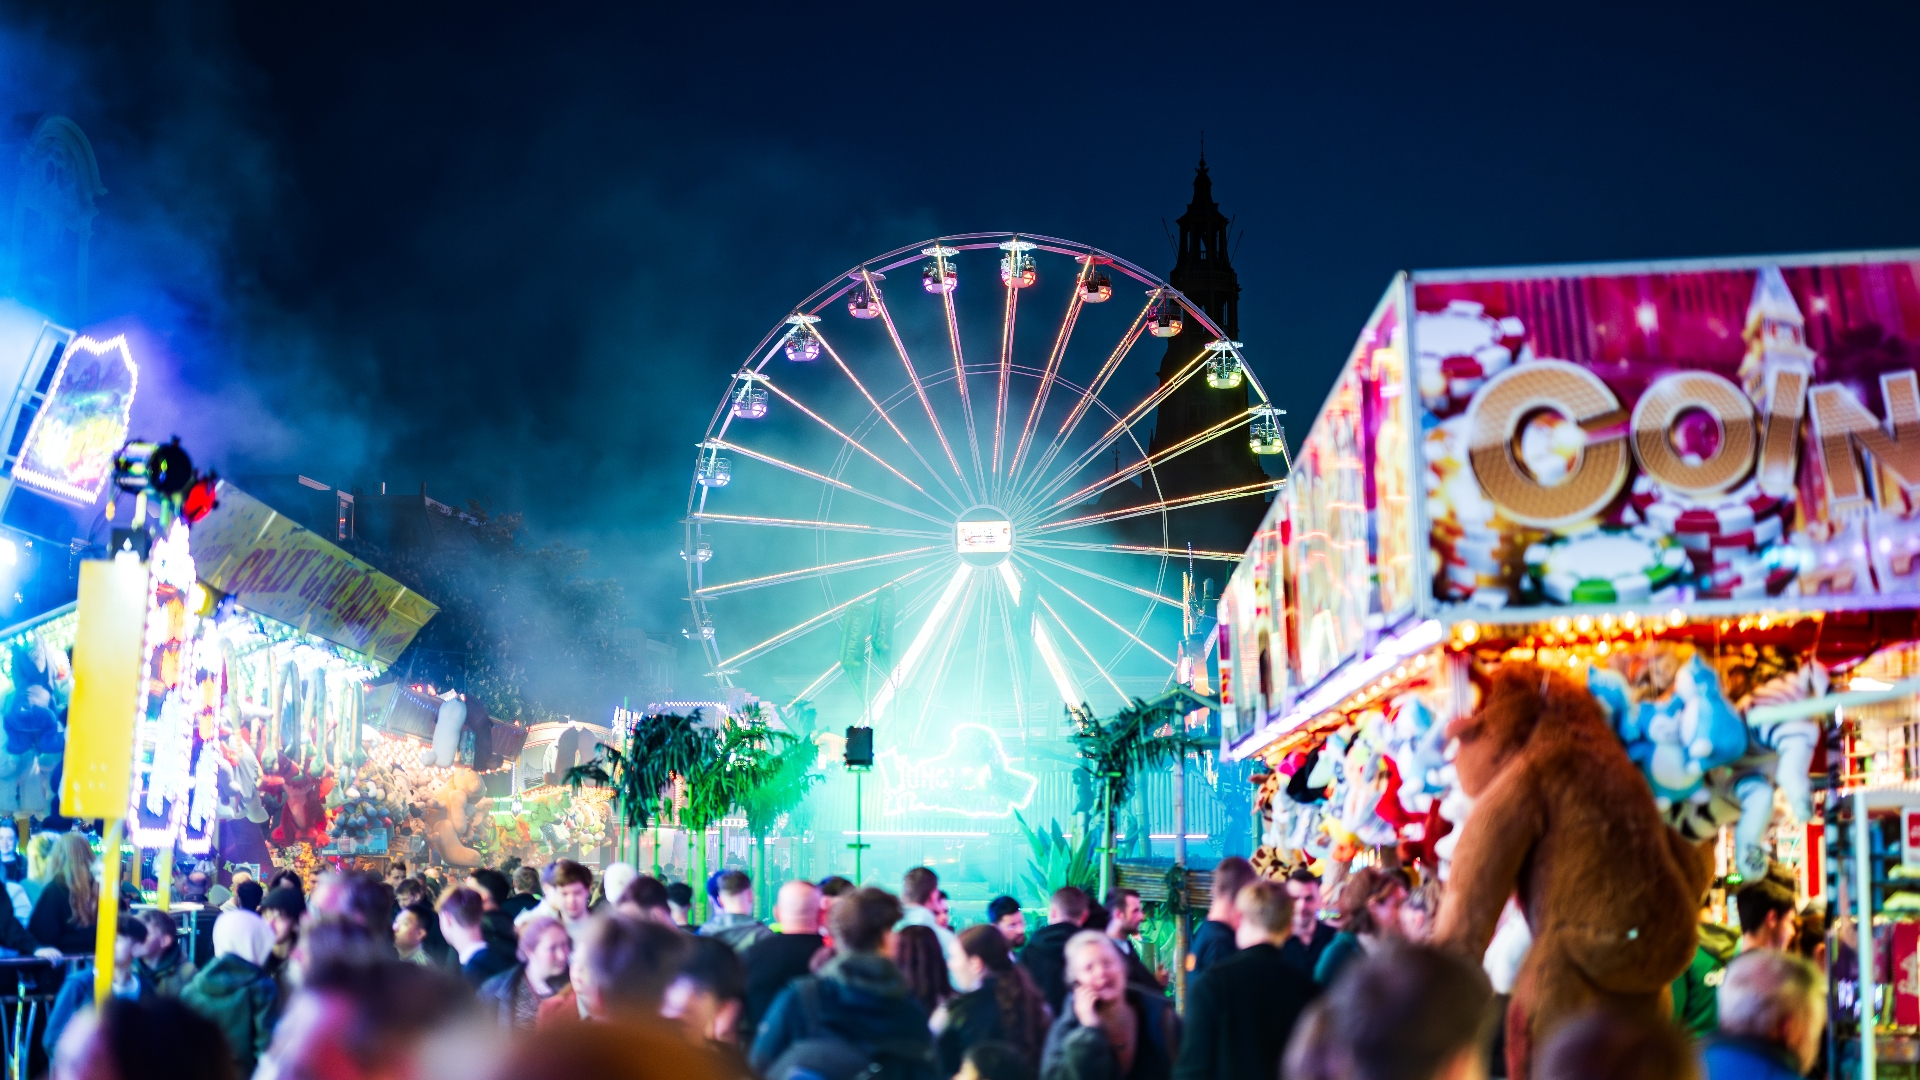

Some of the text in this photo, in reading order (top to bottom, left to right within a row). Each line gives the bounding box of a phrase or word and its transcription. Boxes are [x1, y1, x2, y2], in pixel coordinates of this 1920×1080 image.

[1468, 358, 1920, 528] COIN
[225, 547, 322, 593] CRAZY
[298, 554, 361, 611] GAME
